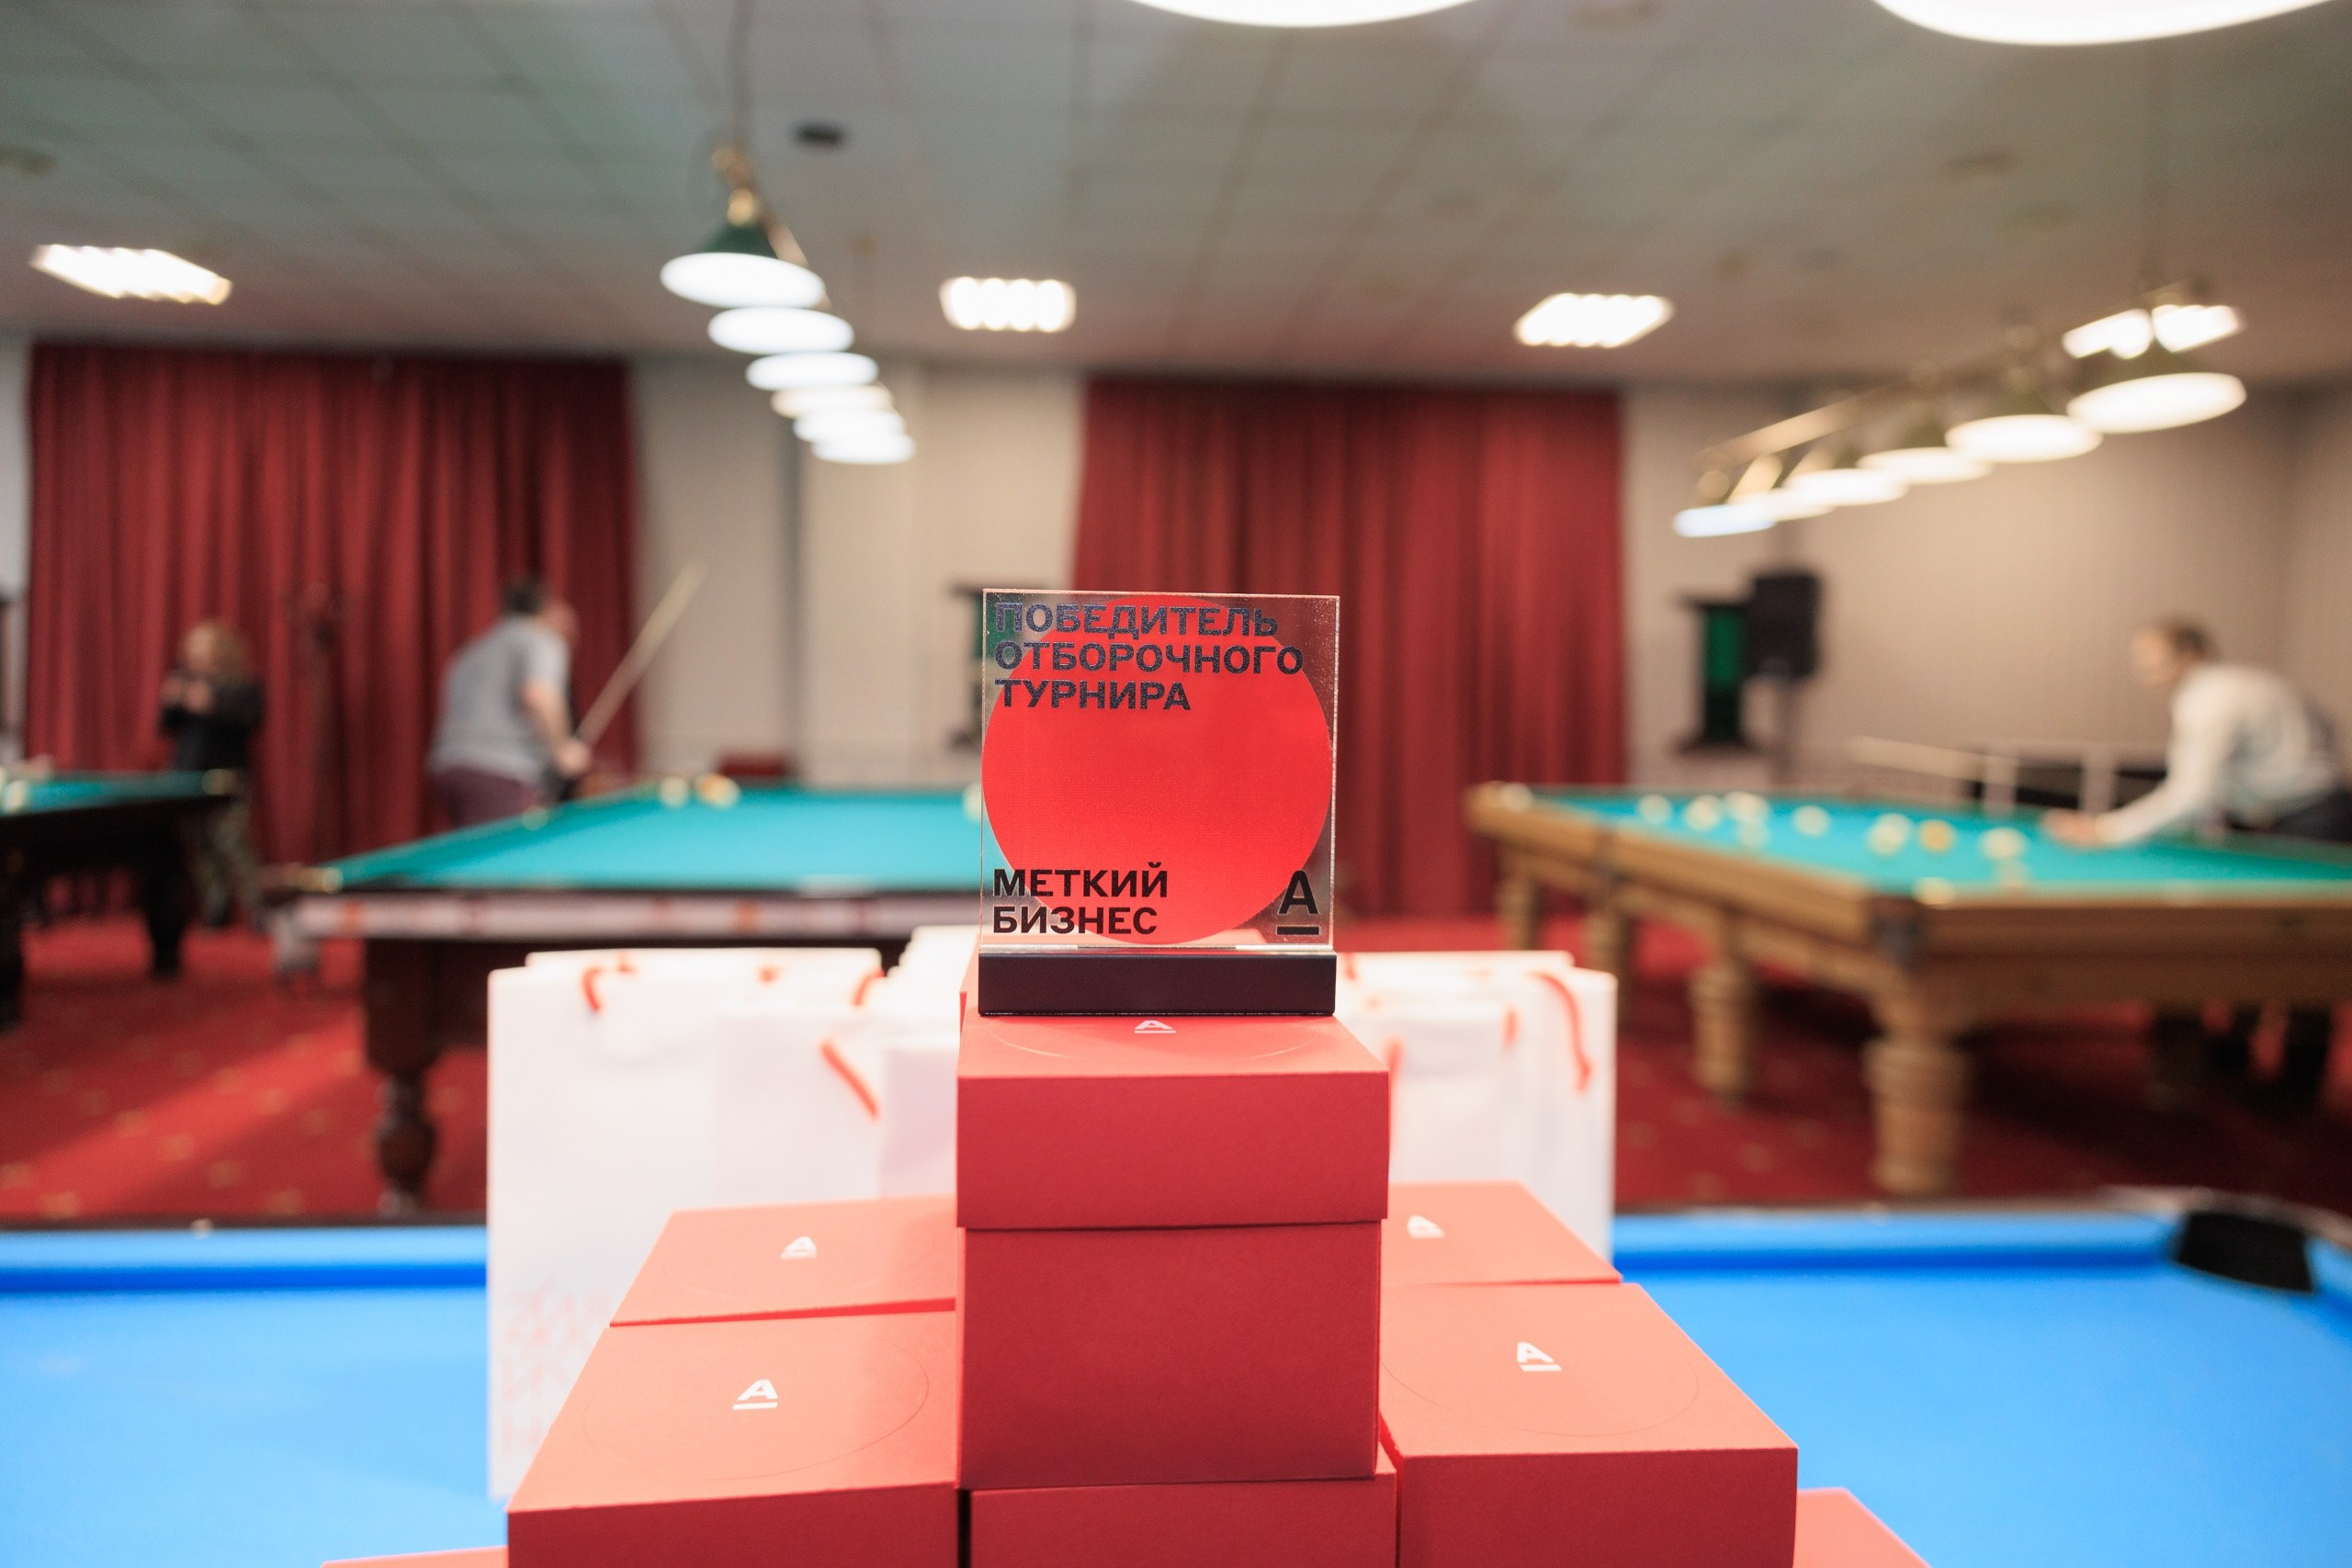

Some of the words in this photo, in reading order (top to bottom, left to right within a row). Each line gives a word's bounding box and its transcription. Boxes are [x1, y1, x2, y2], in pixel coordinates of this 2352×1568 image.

[994, 602, 1278, 640] ПОБЕДИТЕЛЬ
[994, 641, 1304, 675] ОТБОРОЧНОГО
[994, 679, 1192, 711] ТУРНИРА
[993, 861, 1168, 897] МЕТКИЙ
[993, 906, 1158, 935] БИЗНЕС
